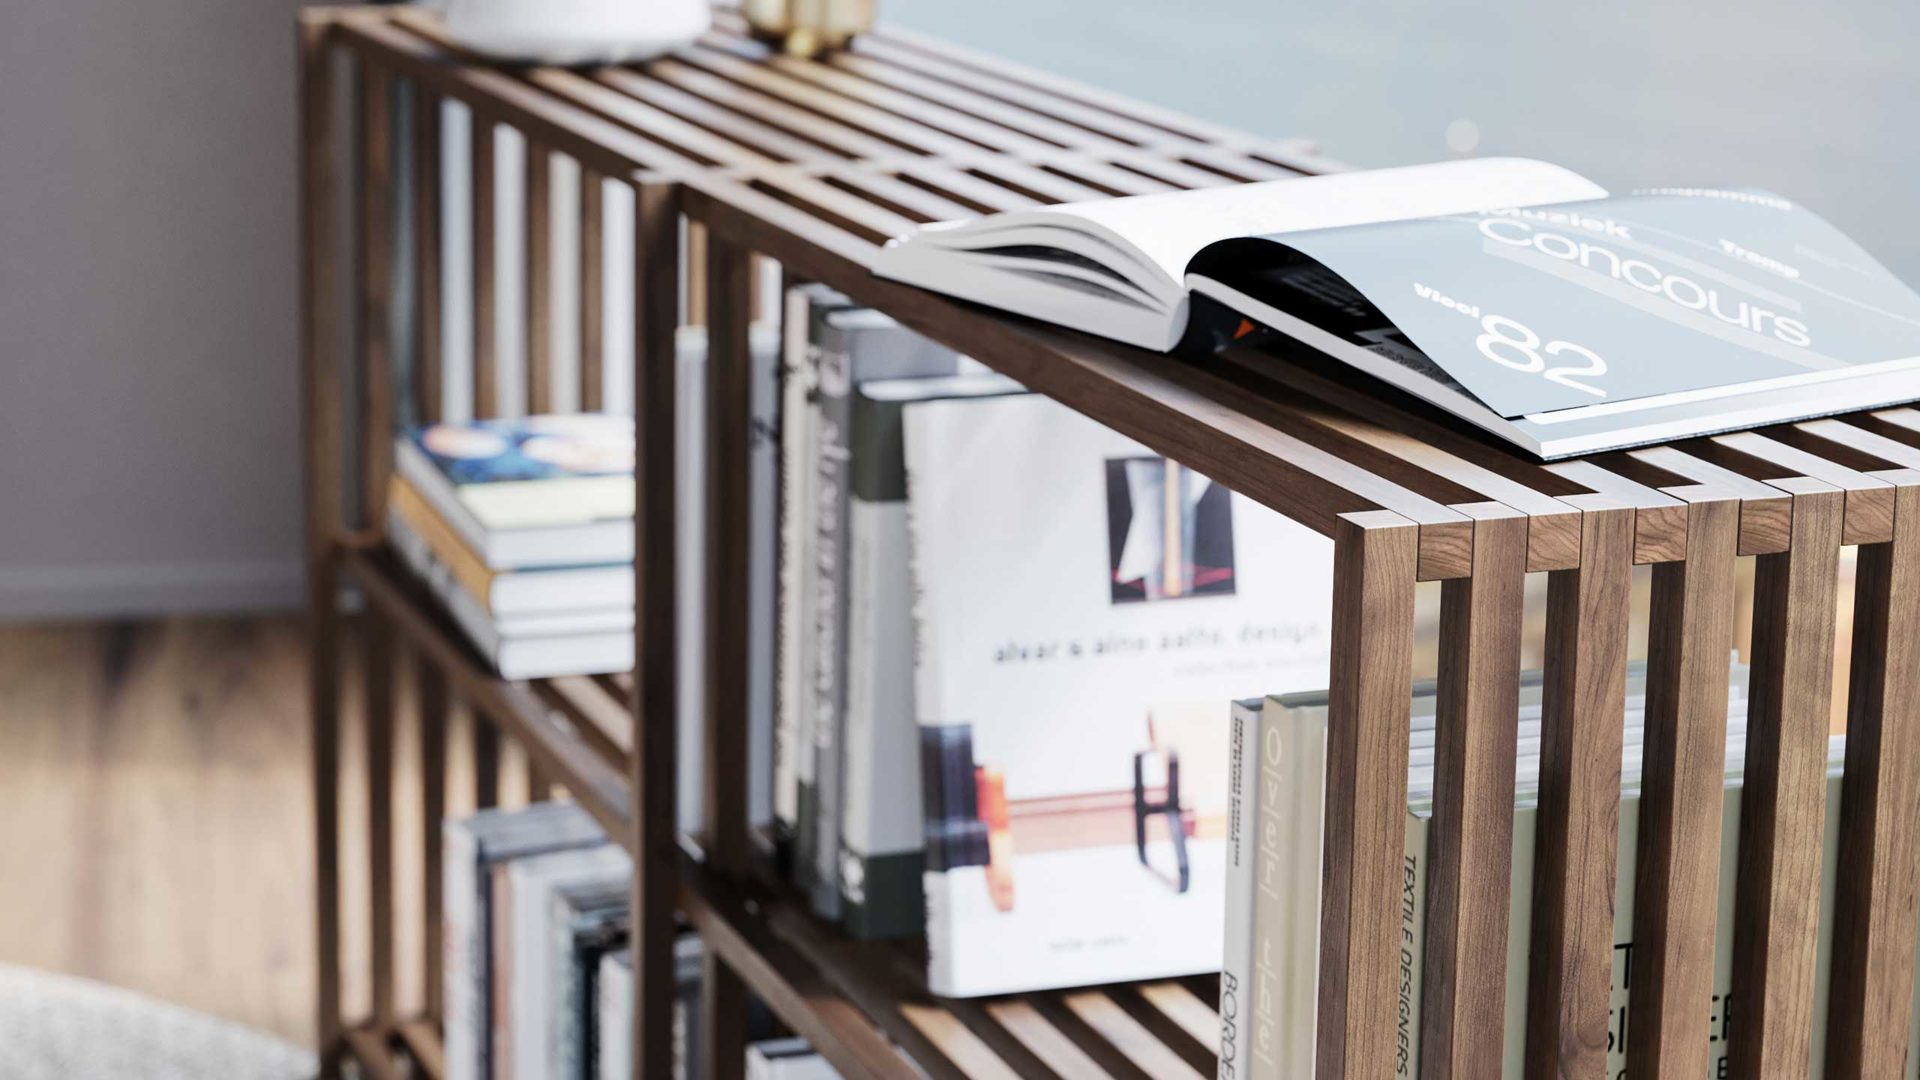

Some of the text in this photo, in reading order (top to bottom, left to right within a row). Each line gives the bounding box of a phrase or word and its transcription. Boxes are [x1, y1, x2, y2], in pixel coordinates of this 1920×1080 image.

[1478, 217, 1811, 347] Concours
[1476, 315, 1608, 397] 82
[1222, 971, 1238, 1080] BORDE
[1396, 856, 1416, 1077] TEXTILE DESIGNERS
